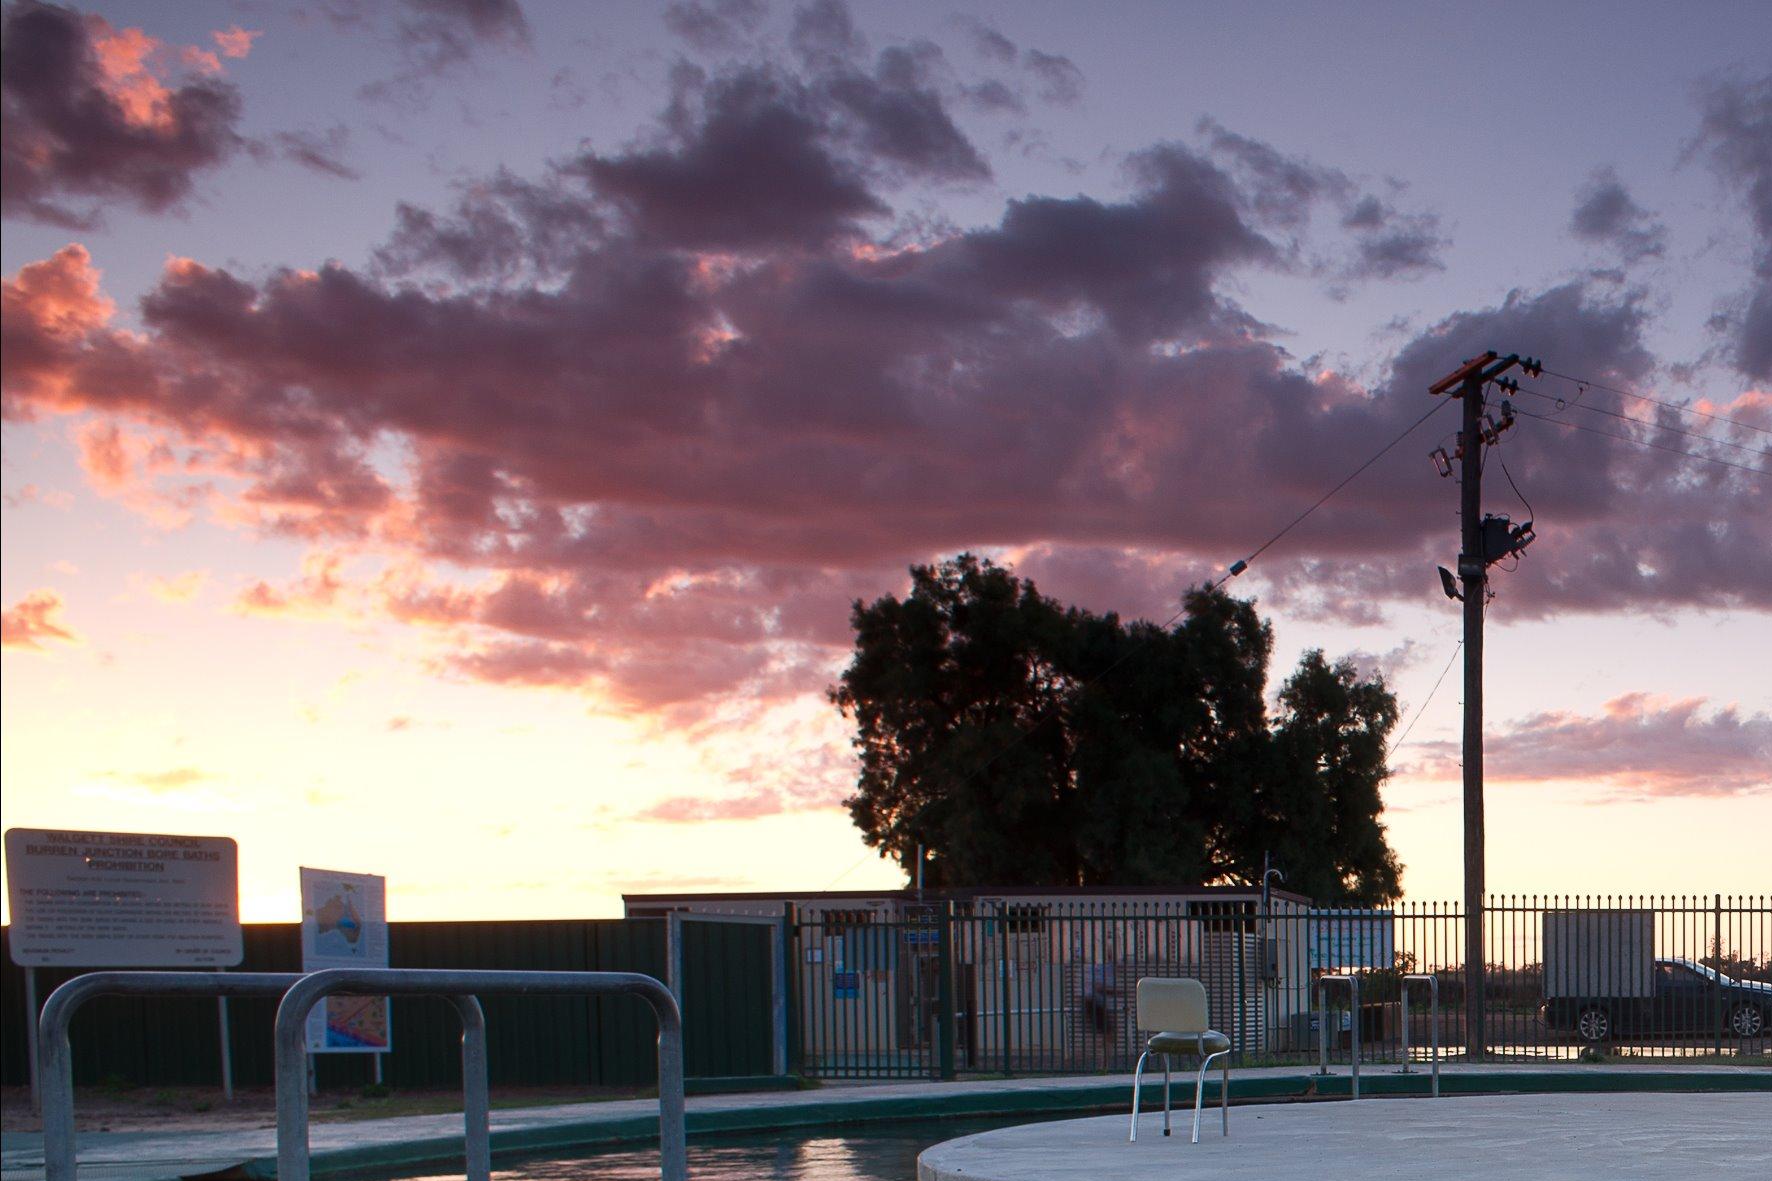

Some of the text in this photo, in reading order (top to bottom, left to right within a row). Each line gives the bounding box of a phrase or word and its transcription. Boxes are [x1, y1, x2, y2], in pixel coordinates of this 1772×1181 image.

[109, 835, 144, 847] SHIRE
[149, 836, 200, 848] COUNCIL
[26, 844, 77, 856] BURREN
[82, 846, 143, 858] JUNCTION
[183, 850, 220, 862] BATHS
[88, 860, 164, 872] PROHIBITION
